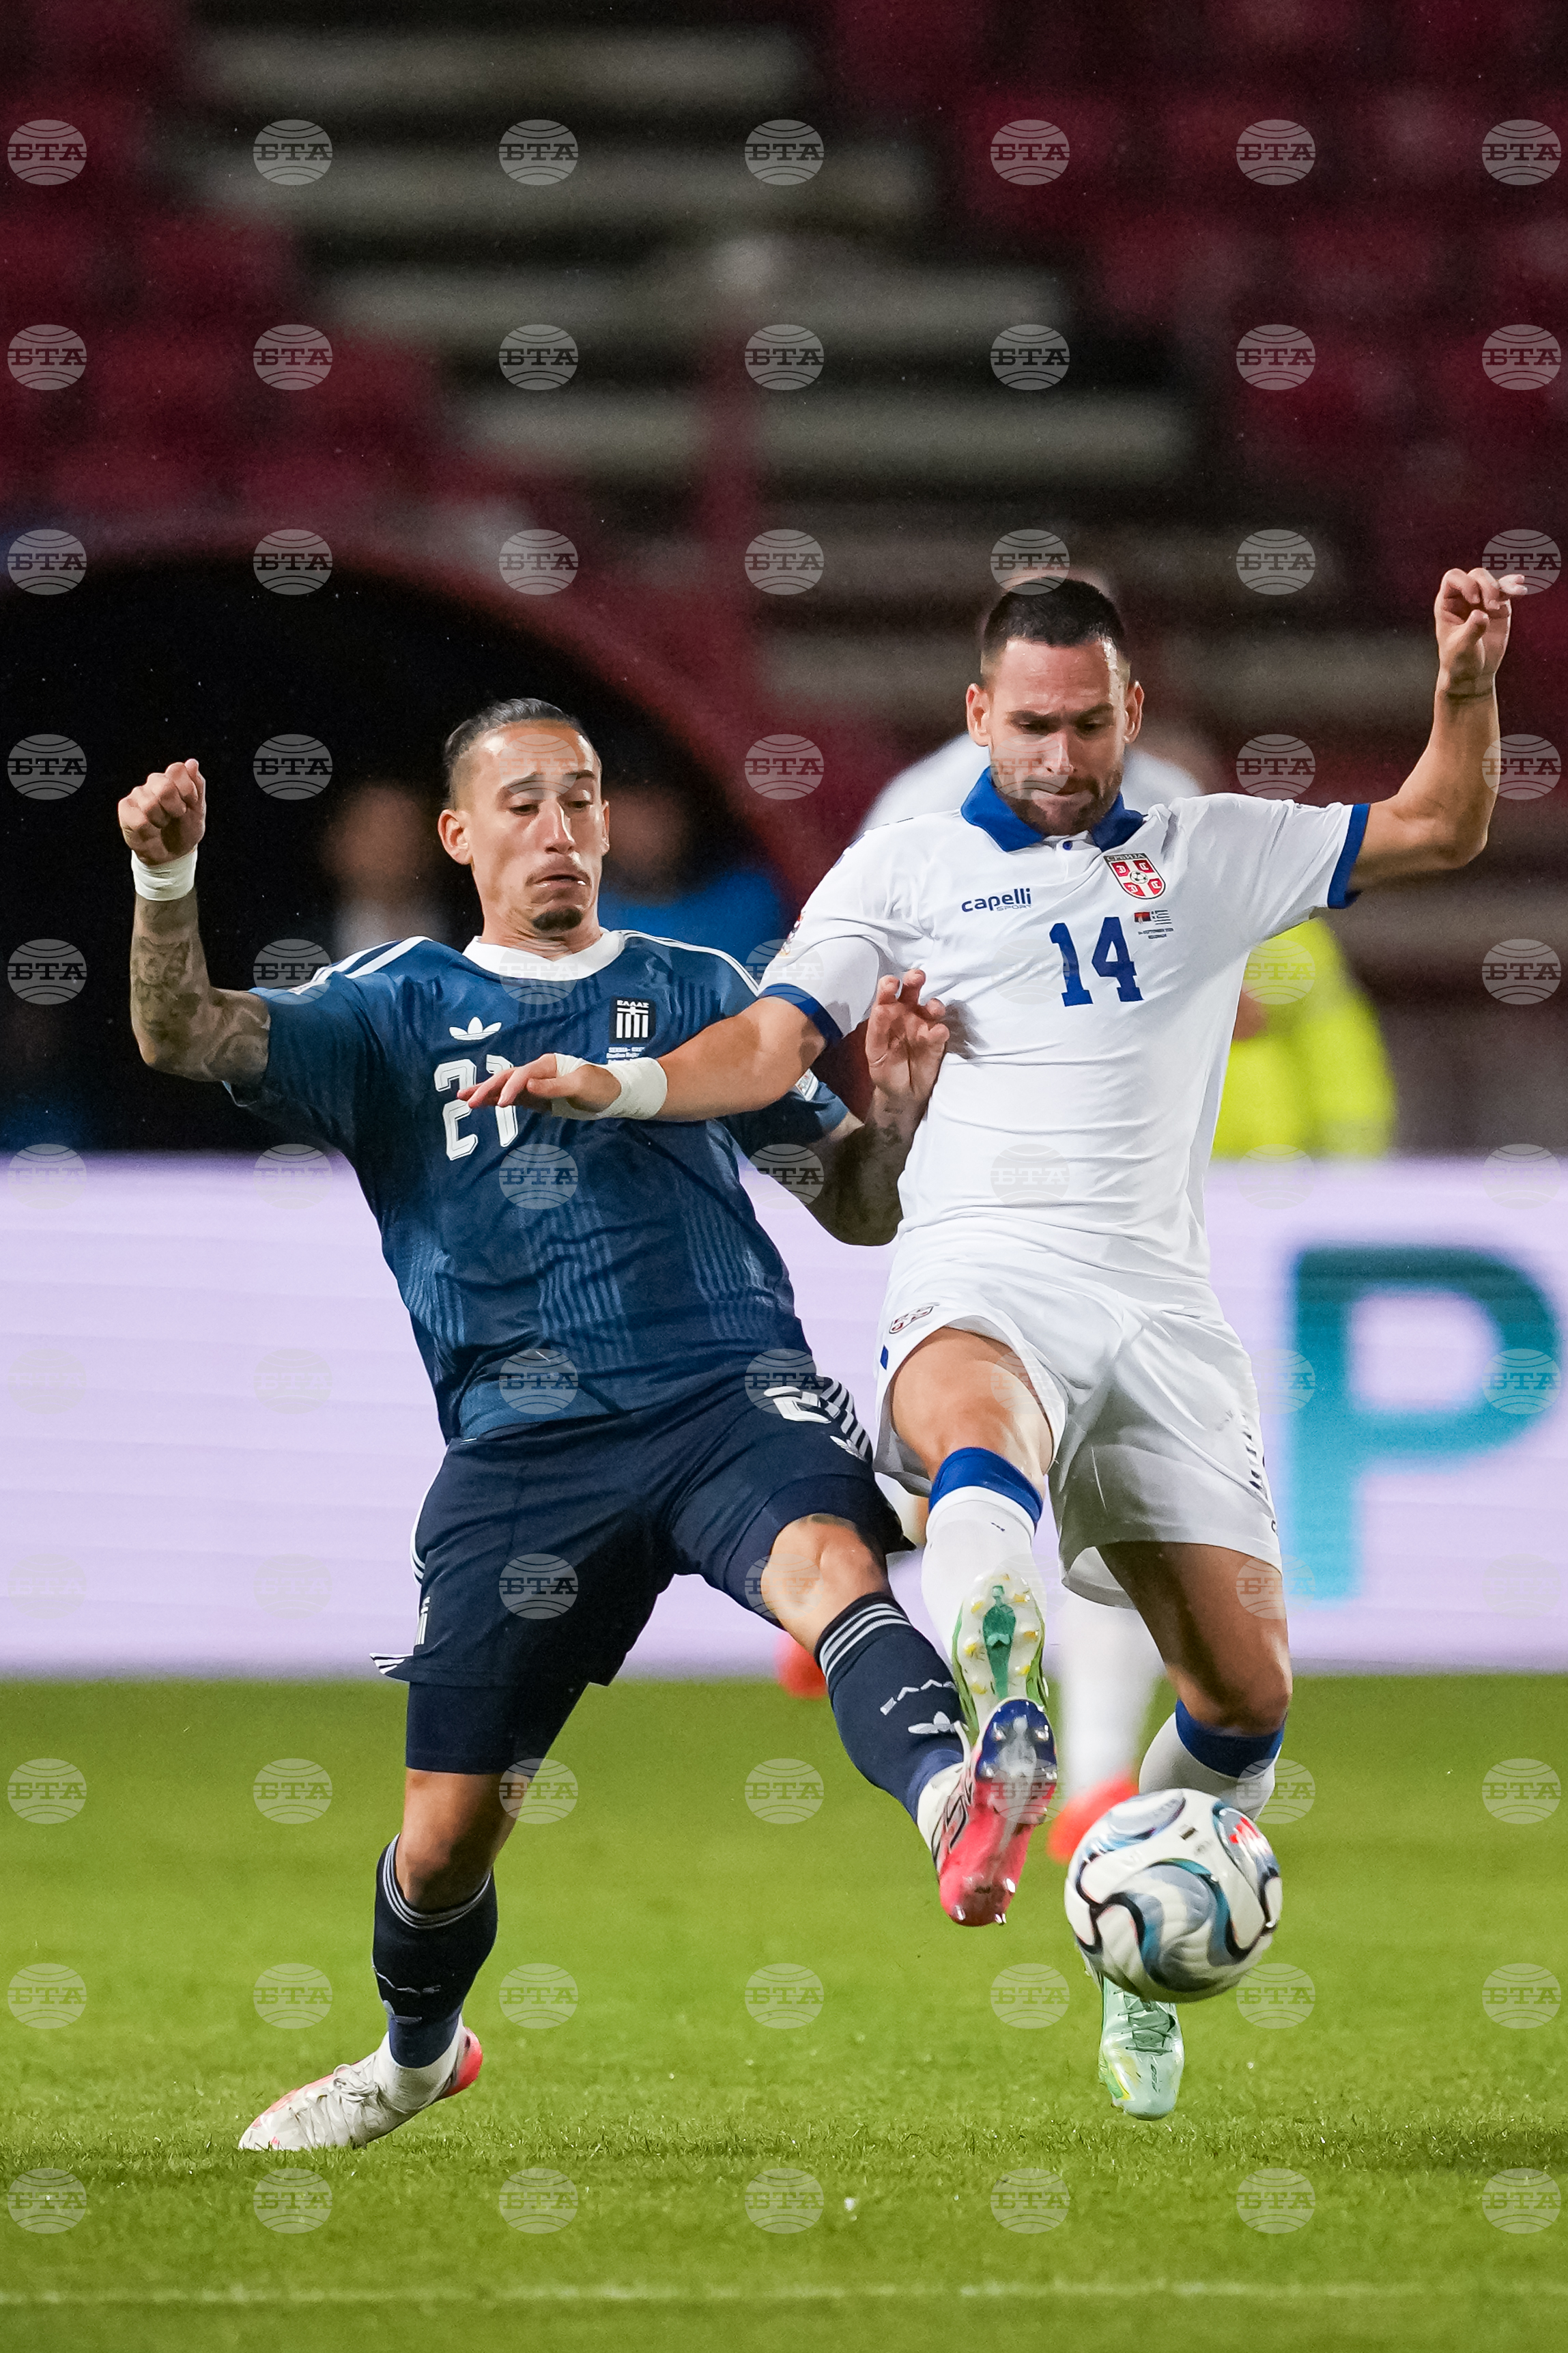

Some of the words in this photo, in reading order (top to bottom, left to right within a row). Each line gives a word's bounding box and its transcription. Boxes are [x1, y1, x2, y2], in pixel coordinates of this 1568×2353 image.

[962, 888, 1031, 912] capelli
[1049, 916, 1144, 1006] 14
[433, 1054, 519, 1160] 21
[1294, 1244, 1560, 1603] P
